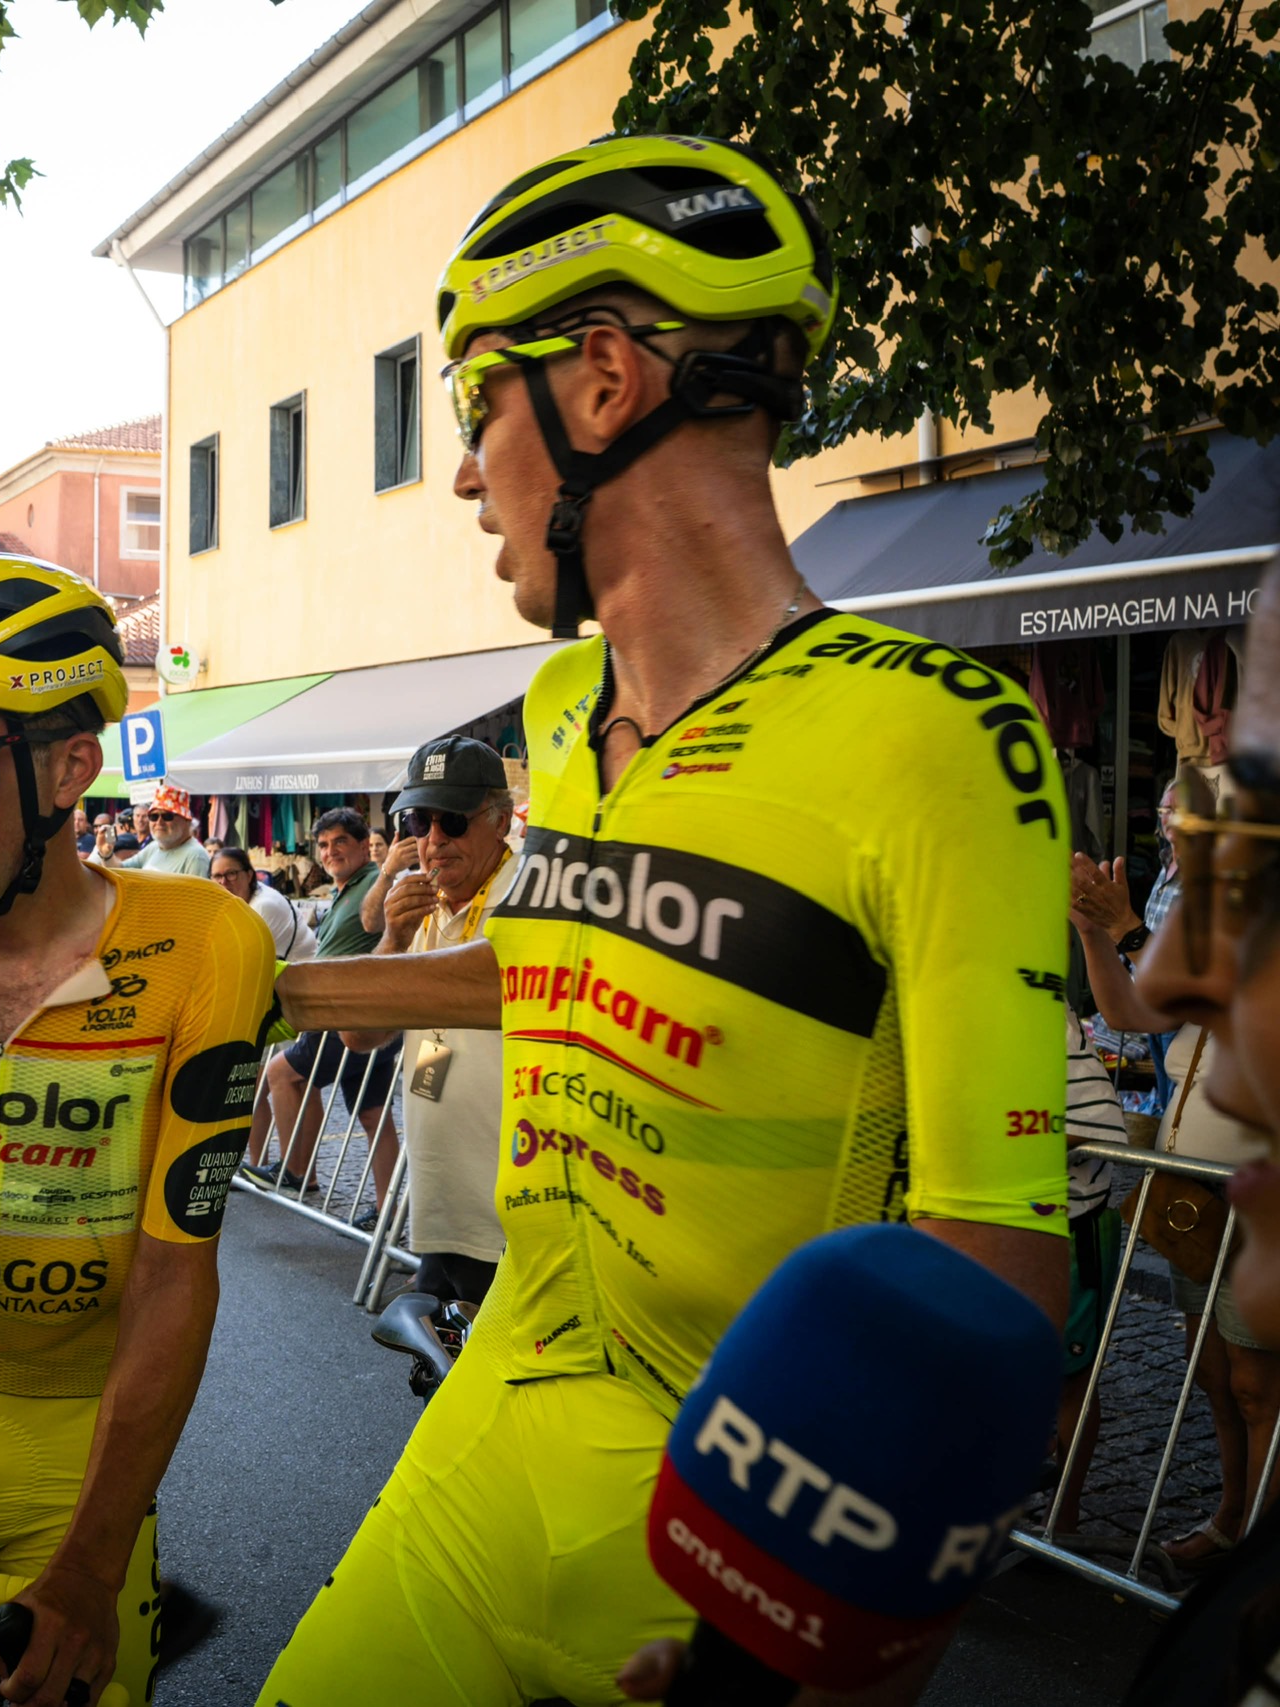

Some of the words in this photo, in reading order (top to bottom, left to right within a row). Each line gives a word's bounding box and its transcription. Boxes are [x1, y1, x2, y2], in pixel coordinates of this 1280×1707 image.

[667, 187, 752, 223] KASK
[488, 223, 605, 282] PROJECT
[1020, 596, 1176, 636] ESTAMPAGEM
[1183, 592, 1220, 621] NA
[1227, 587, 1265, 617] HO
[10, 675, 24, 690] X
[29, 659, 104, 686] PROJECT
[127, 717, 156, 777] P
[235, 775, 263, 791] LINHOS
[269, 773, 320, 790] ARTESANATO
[506, 838, 745, 962] nicolor
[123, 938, 176, 962] PACTO
[86, 1005, 137, 1024] VOLTA
[88, 1020, 134, 1032] PORTUGAL
[199, 1151, 239, 1168] QUANDO
[195, 1168, 209, 1184] 1
[185, 1200, 211, 1217] 2
[695, 1393, 900, 1552] RTP
[666, 1516, 795, 1633] antena
[797, 1612, 826, 1650] 1
